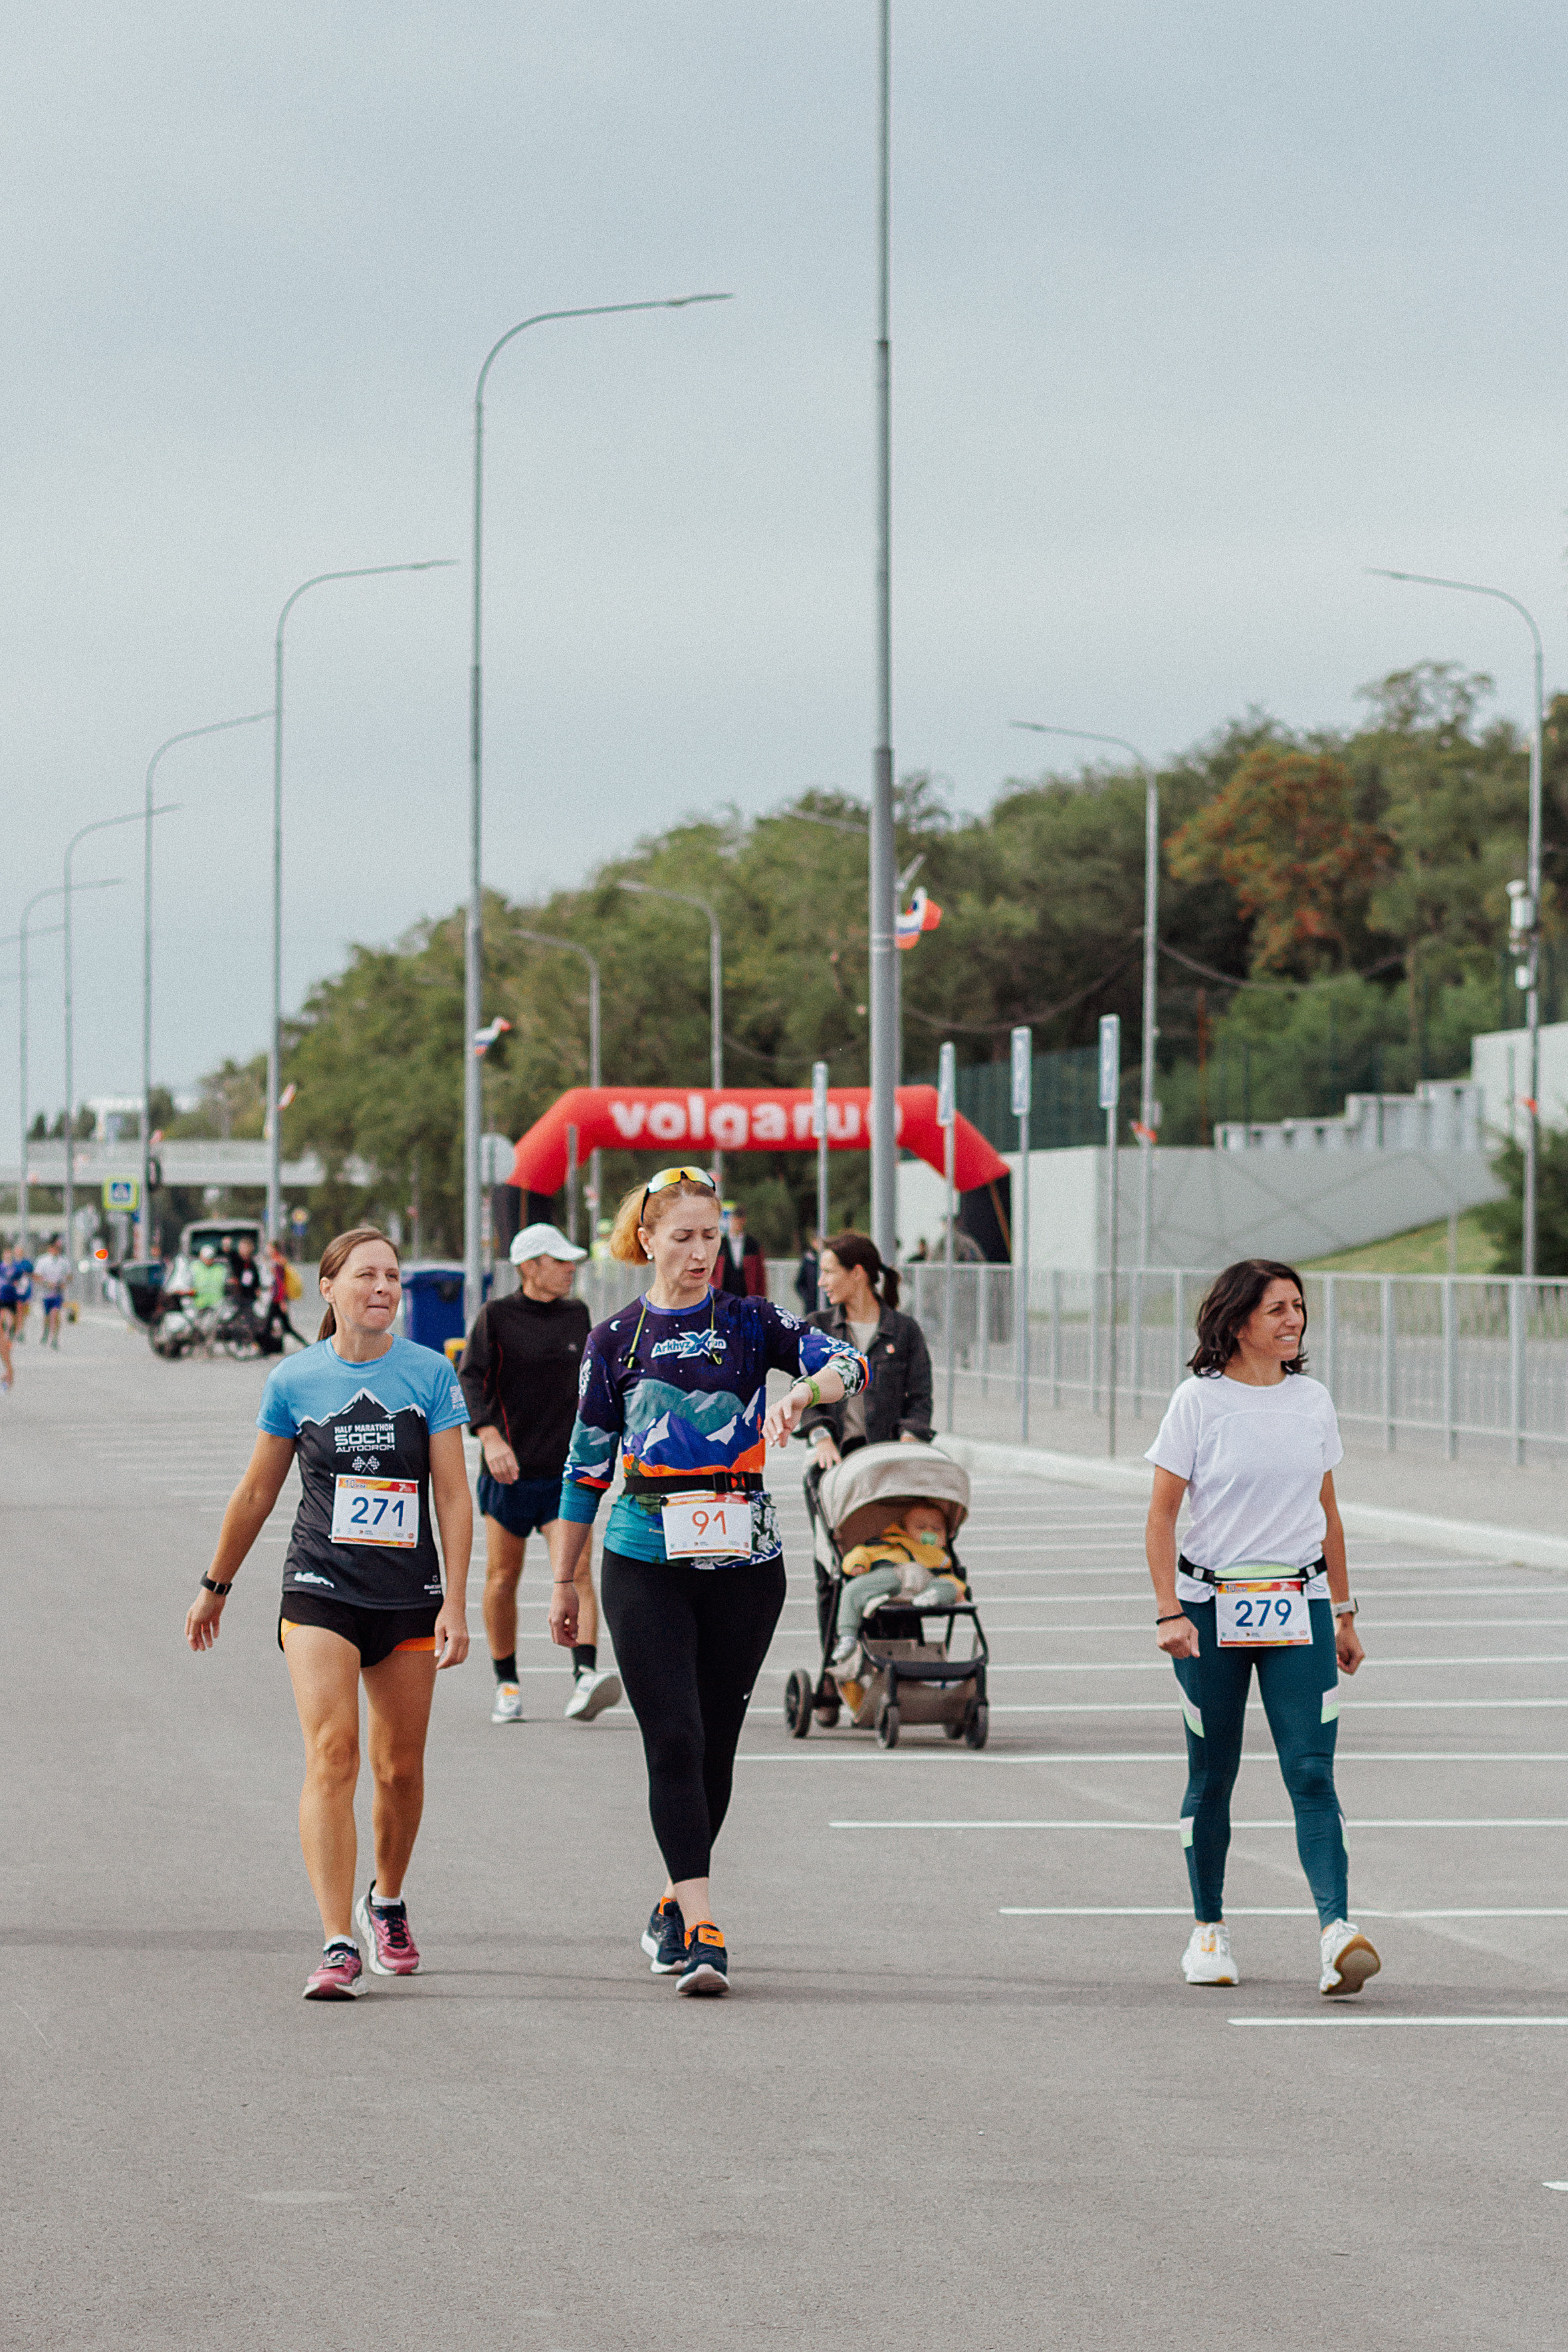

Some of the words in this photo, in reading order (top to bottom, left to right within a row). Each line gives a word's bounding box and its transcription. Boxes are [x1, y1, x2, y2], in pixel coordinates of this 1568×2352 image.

[608, 1094, 903, 1147] volgaru
[654, 1340, 691, 1353] Arkhyz
[354, 1423, 393, 1432] MARATHON
[334, 1432, 395, 1446] SOCHI
[335, 1444, 395, 1453] AUTODROM
[350, 1496, 405, 1527] 271
[692, 1510, 727, 1536] 91
[1235, 1598, 1292, 1627] 279
